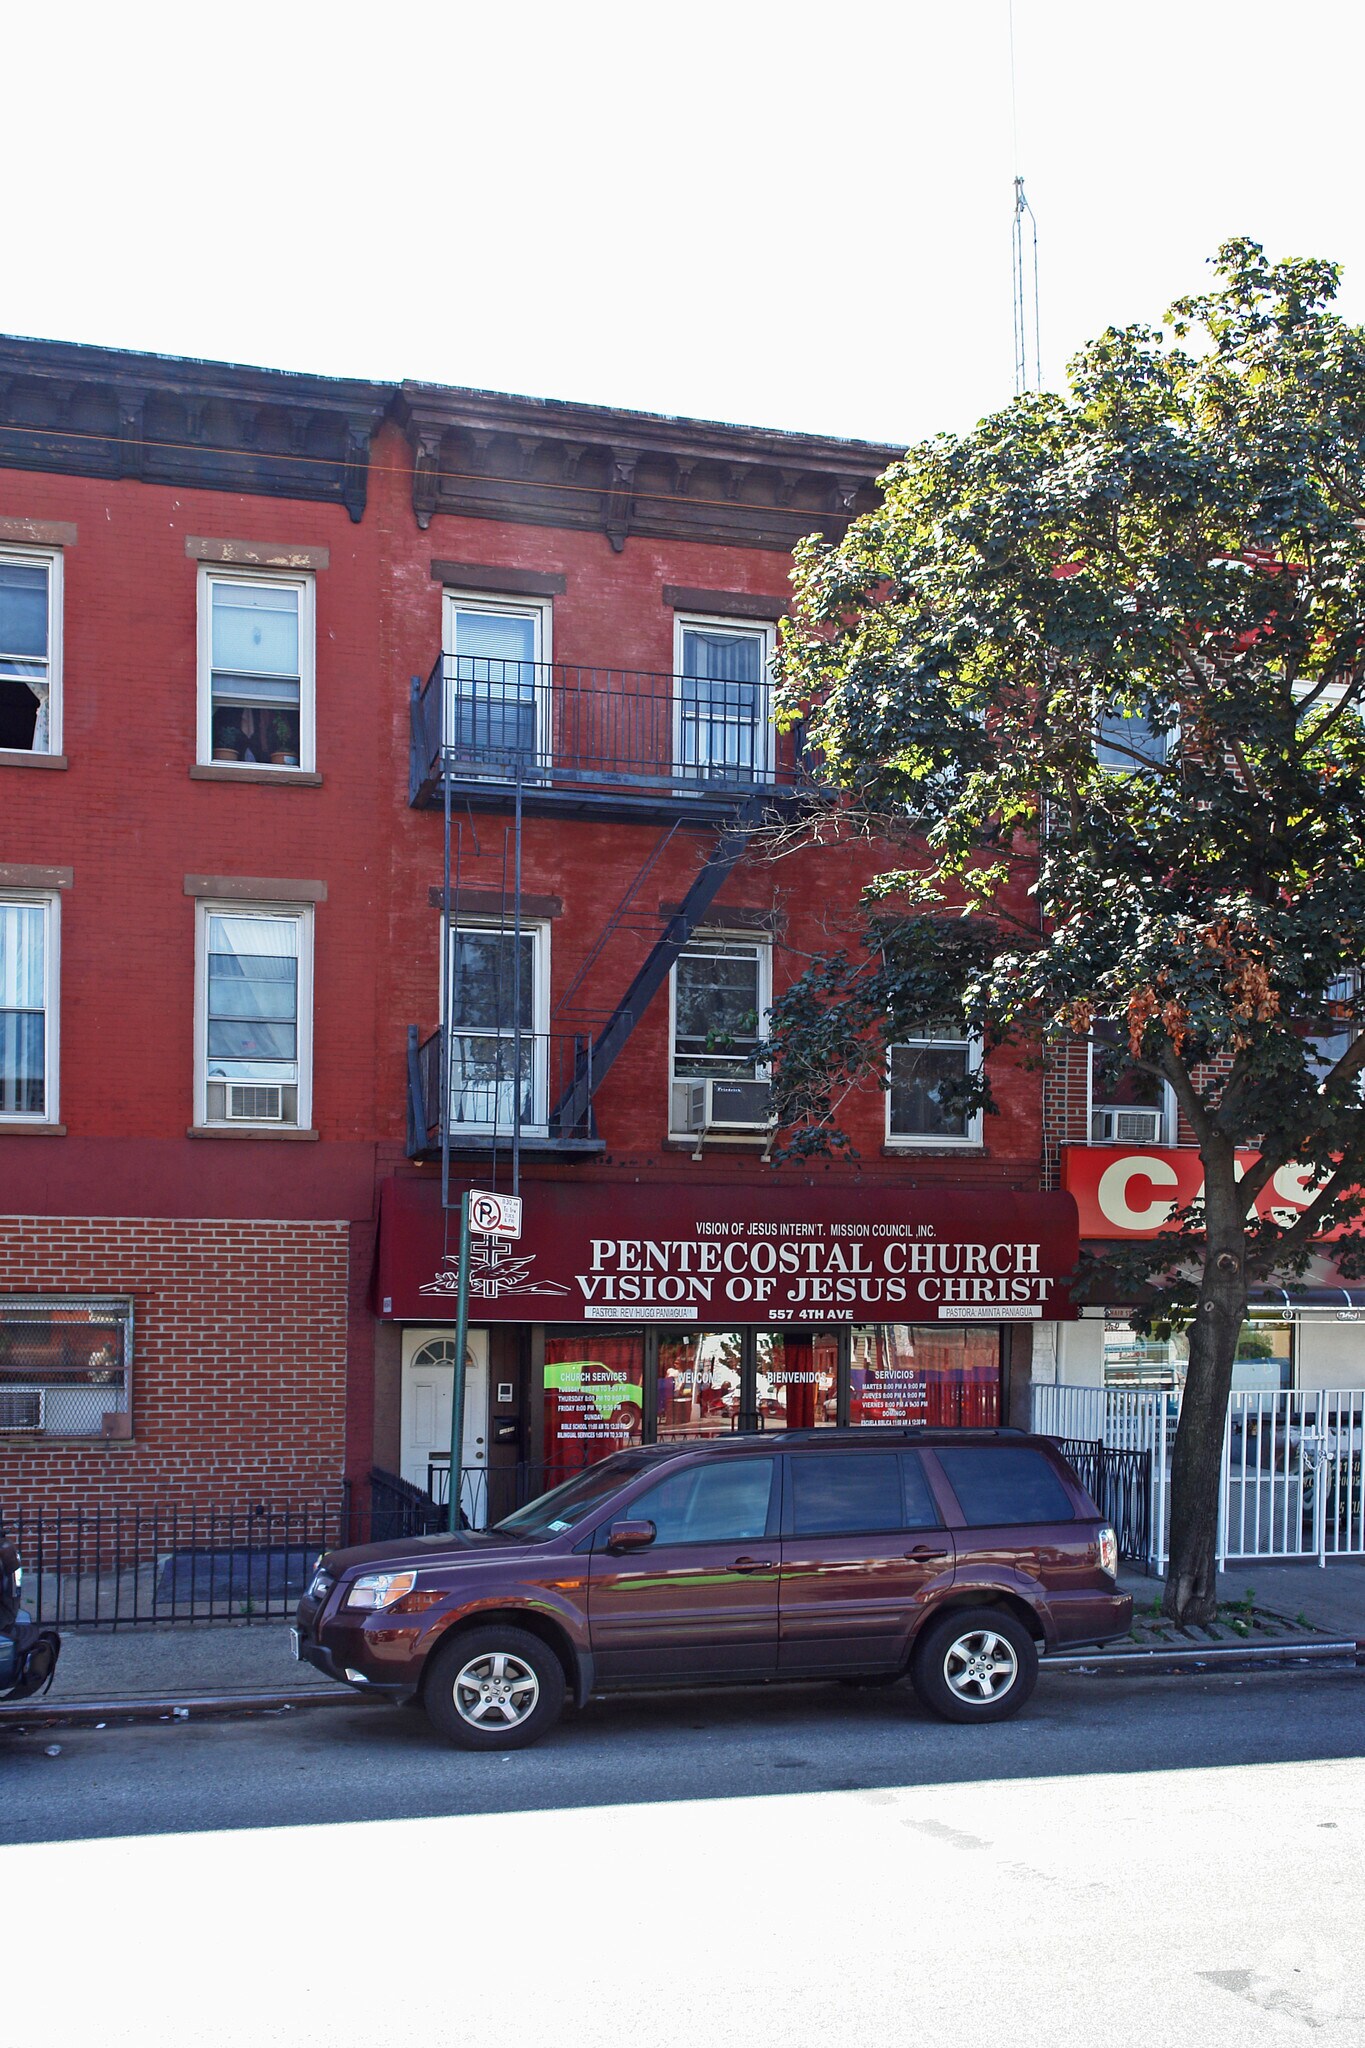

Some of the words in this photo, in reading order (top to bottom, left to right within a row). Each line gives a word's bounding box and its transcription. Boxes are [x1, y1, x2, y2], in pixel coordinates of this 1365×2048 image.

[696, 1222, 728, 1236] VISION
[731, 1222, 744, 1236] OF
[746, 1223, 778, 1236] JESUS
[830, 1224, 870, 1236] MISSION
[872, 1224, 913, 1237] COUNCIL
[589, 1240, 873, 1274] PENTECOSTAL
[884, 1243, 1040, 1274] CHURCH
[574, 1276, 715, 1300] VISION
[726, 1276, 777, 1301] OF
[787, 1277, 907, 1301] JESUS
[917, 1278, 1054, 1301] CHRIST
[636, 1308, 654, 1317] HUGO
[768, 1310, 794, 1319] 557
[799, 1310, 824, 1319] 4TH
[827, 1310, 854, 1319] AVE
[978, 1308, 1000, 1317] AMINTA
[1002, 1308, 1033, 1316] PANIAGUA
[561, 1372, 590, 1381] CHURCH
[592, 1372, 627, 1381] SERVICES
[678, 1372, 721, 1384] WELCOME
[767, 1372, 826, 1384] BIENVENIDOS
[875, 1371, 914, 1379] SERVICIOS
